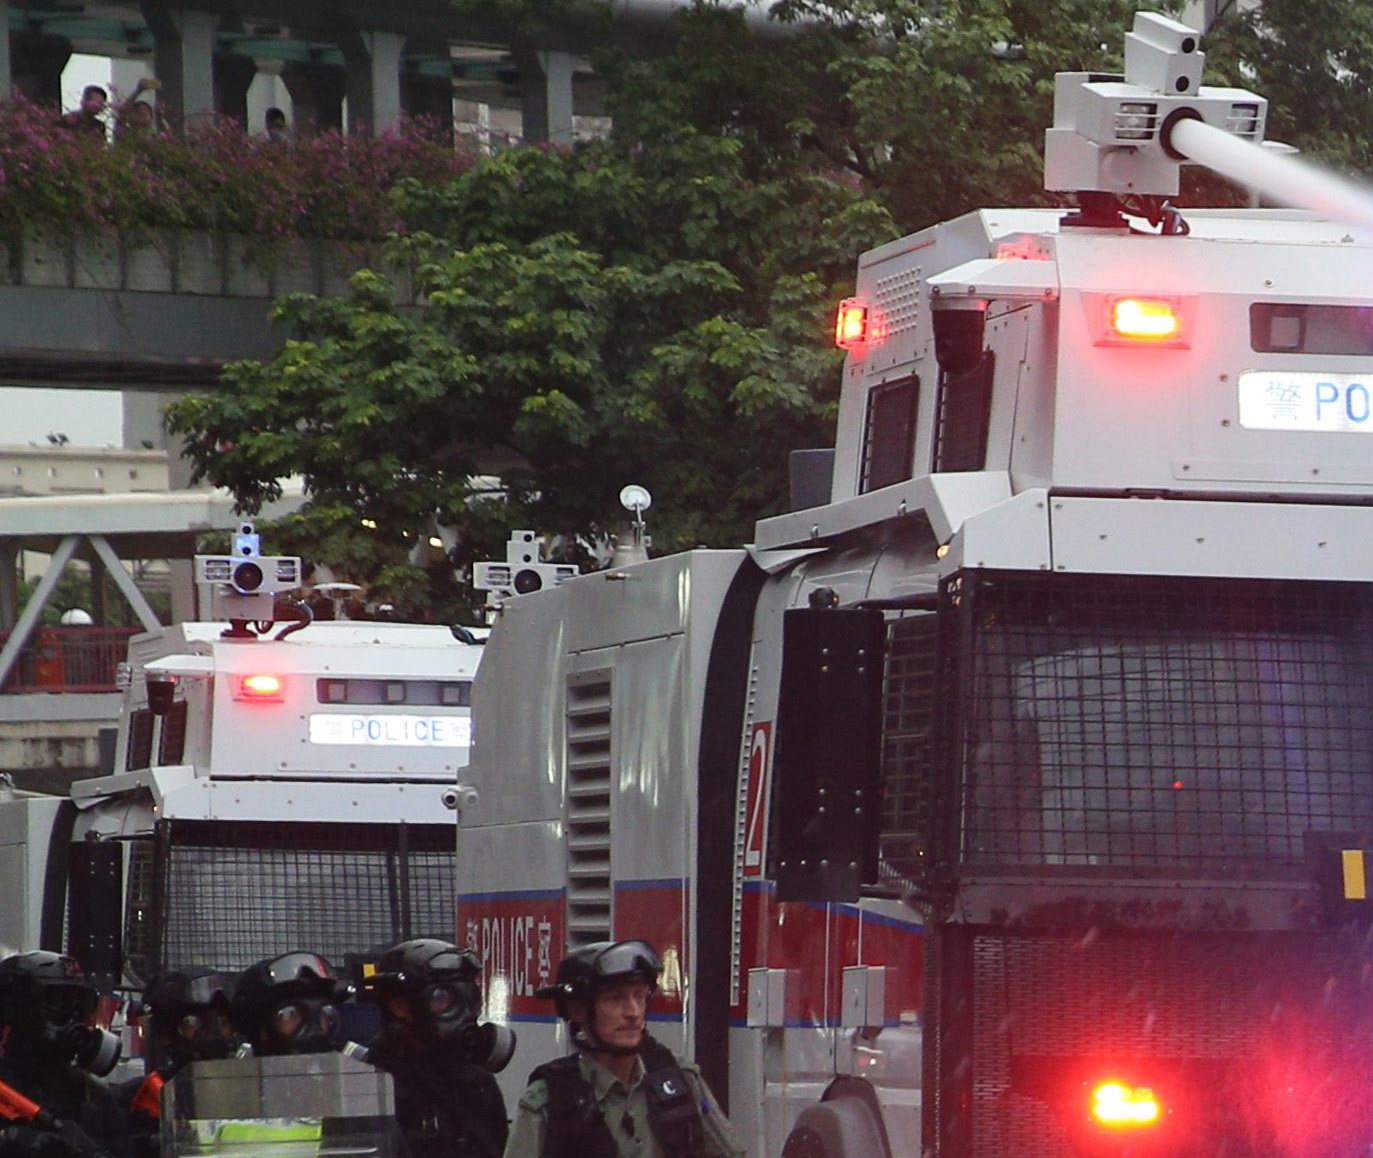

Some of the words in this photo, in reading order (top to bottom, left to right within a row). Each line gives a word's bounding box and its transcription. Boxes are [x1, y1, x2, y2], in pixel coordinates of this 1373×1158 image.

[1264, 379, 1304, 422] 警
[350, 719, 445, 742] POLICE
[481, 916, 534, 998] POLICE
